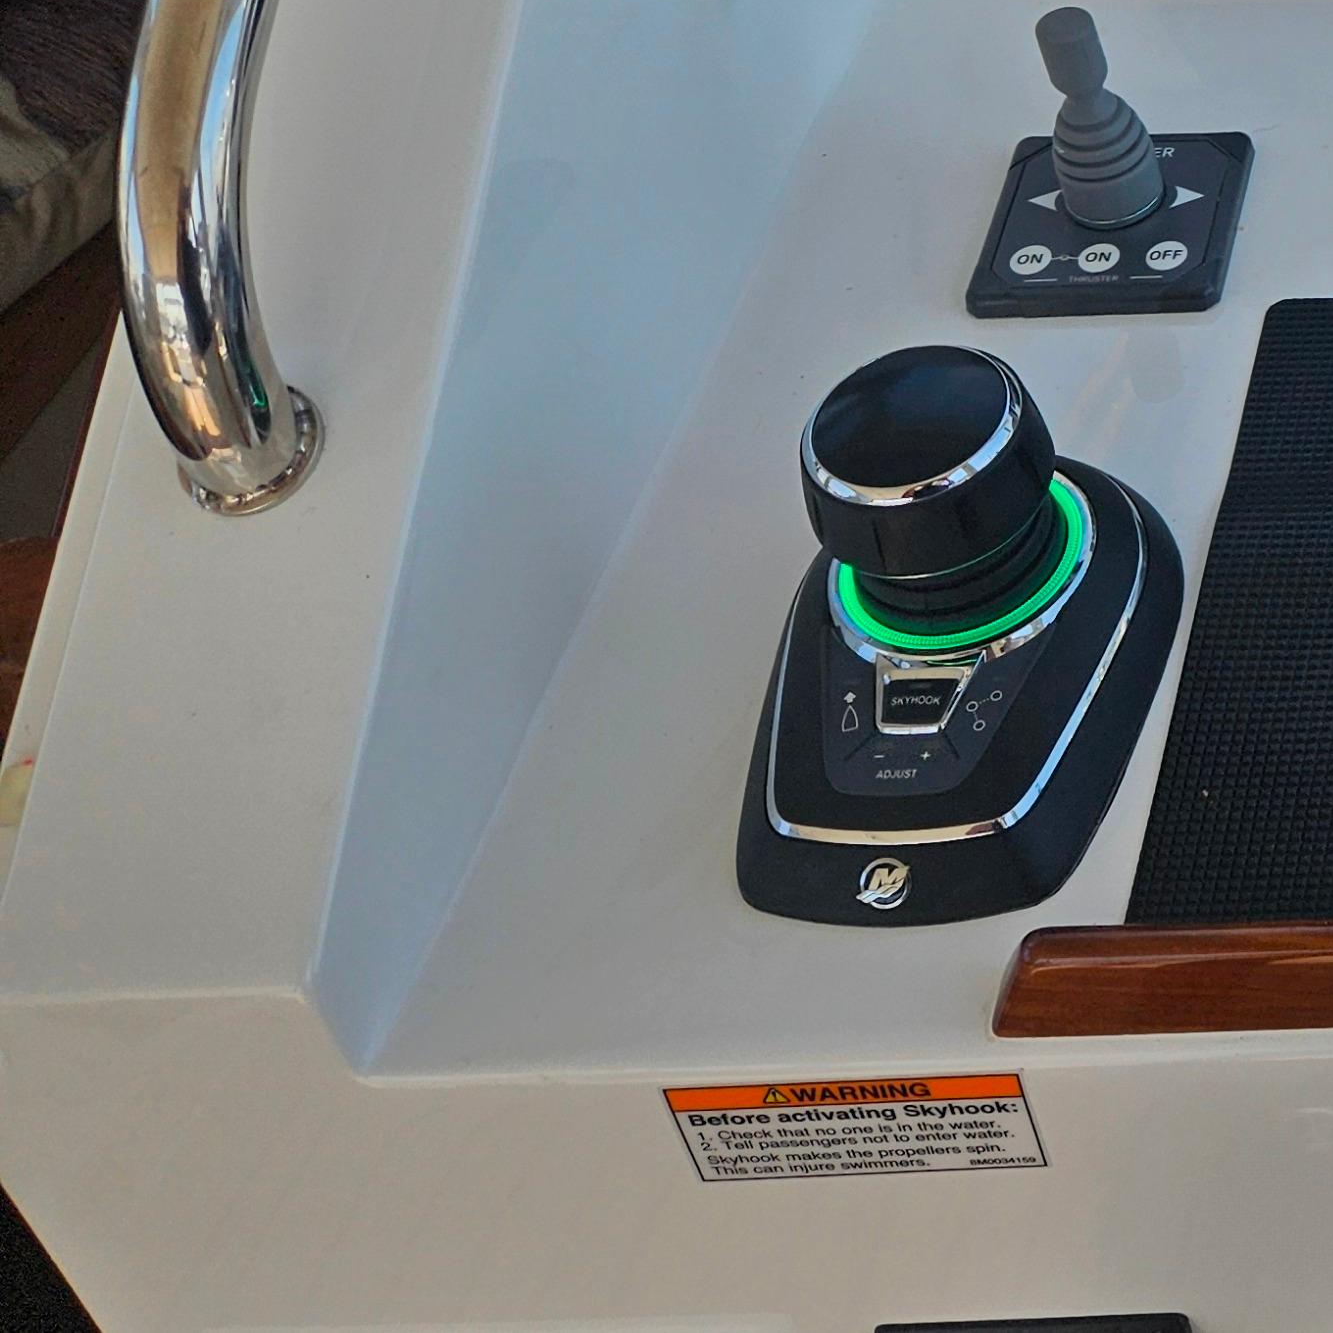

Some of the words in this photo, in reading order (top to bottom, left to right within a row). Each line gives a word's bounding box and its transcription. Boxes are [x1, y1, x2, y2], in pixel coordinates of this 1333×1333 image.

[1017, 253, 1043, 265] ON
[1085, 252, 1112, 263] ON
[1150, 249, 1183, 261] OFF
[890, 695, 942, 706] SKYHOOK
[875, 769, 918, 779] ADJUST
[789, 1082, 931, 1102] WARNING
[688, 1113, 771, 1127] Before
[778, 1106, 896, 1124] activating
[903, 1101, 1018, 1119] Skyhook:
[698, 1132, 713, 1142] 1.
[717, 1128, 774, 1141] Check
[777, 1127, 810, 1138] that
[815, 1126, 837, 1136] no
[842, 1125, 873, 1135] one
[879, 1124, 893, 1134] is
[897, 1123, 912, 1133] in
[918, 1122, 944, 1132] the
[949, 1120, 1001, 1131] water.
[700, 1141, 718, 1152] 2.
[724, 1140, 753, 1151] Tell
[758, 1137, 858, 1151] passengers
[863, 1134, 889, 1144] not
[893, 1133, 910, 1143] to
[915, 1131, 958, 1142] enter
[963, 1129, 1015, 1141] water.
[707, 1152, 781, 1166] Skyhook
[785, 1150, 842, 1163] makes
[846, 1148, 873, 1158] the
[878, 1144, 962, 1159] propellers
[966, 1143, 1006, 1155] spin.
[711, 1165, 749, 1176] This
[753, 1164, 784, 1174] can
[788, 1162, 836, 1174] injure
[840, 1158, 930, 1171] swimmers.
